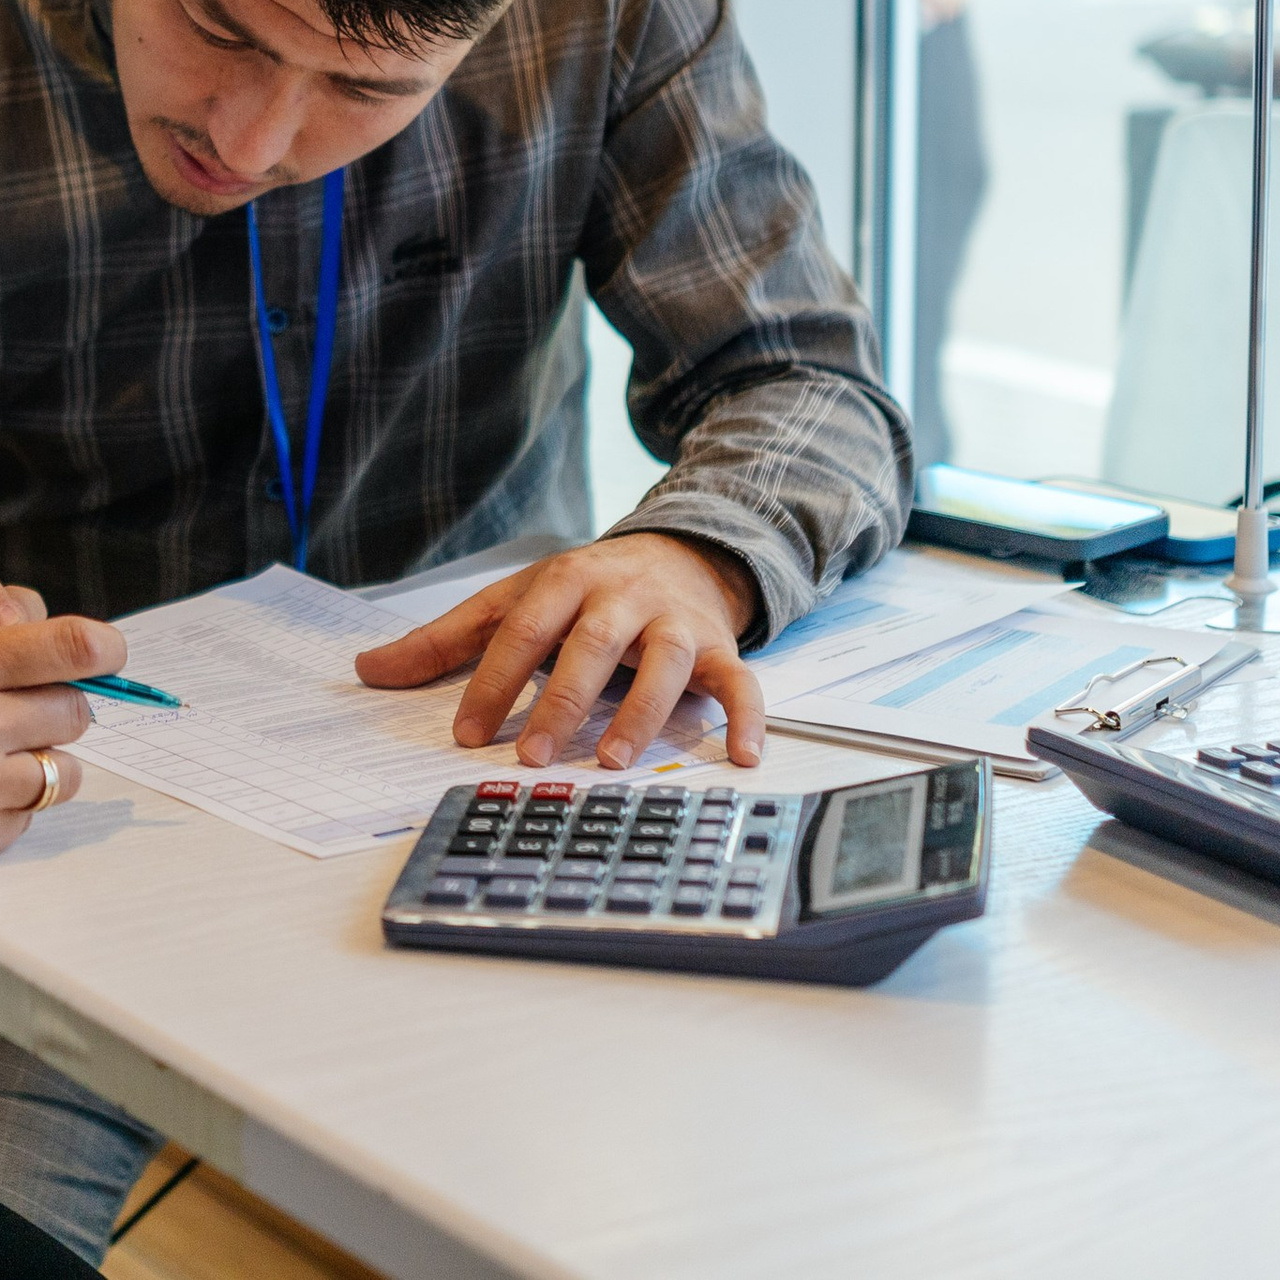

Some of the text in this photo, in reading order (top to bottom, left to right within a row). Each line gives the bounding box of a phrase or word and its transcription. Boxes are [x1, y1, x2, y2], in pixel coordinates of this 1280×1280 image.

[590, 805, 613, 815] 4
[649, 807, 673, 817] 7
[525, 822, 549, 832] 2
[582, 823, 607, 833] 5
[640, 825, 664, 835] 8
[517, 840, 542, 851] 3
[575, 841, 599, 853] 6
[633, 844, 658, 855] 9
